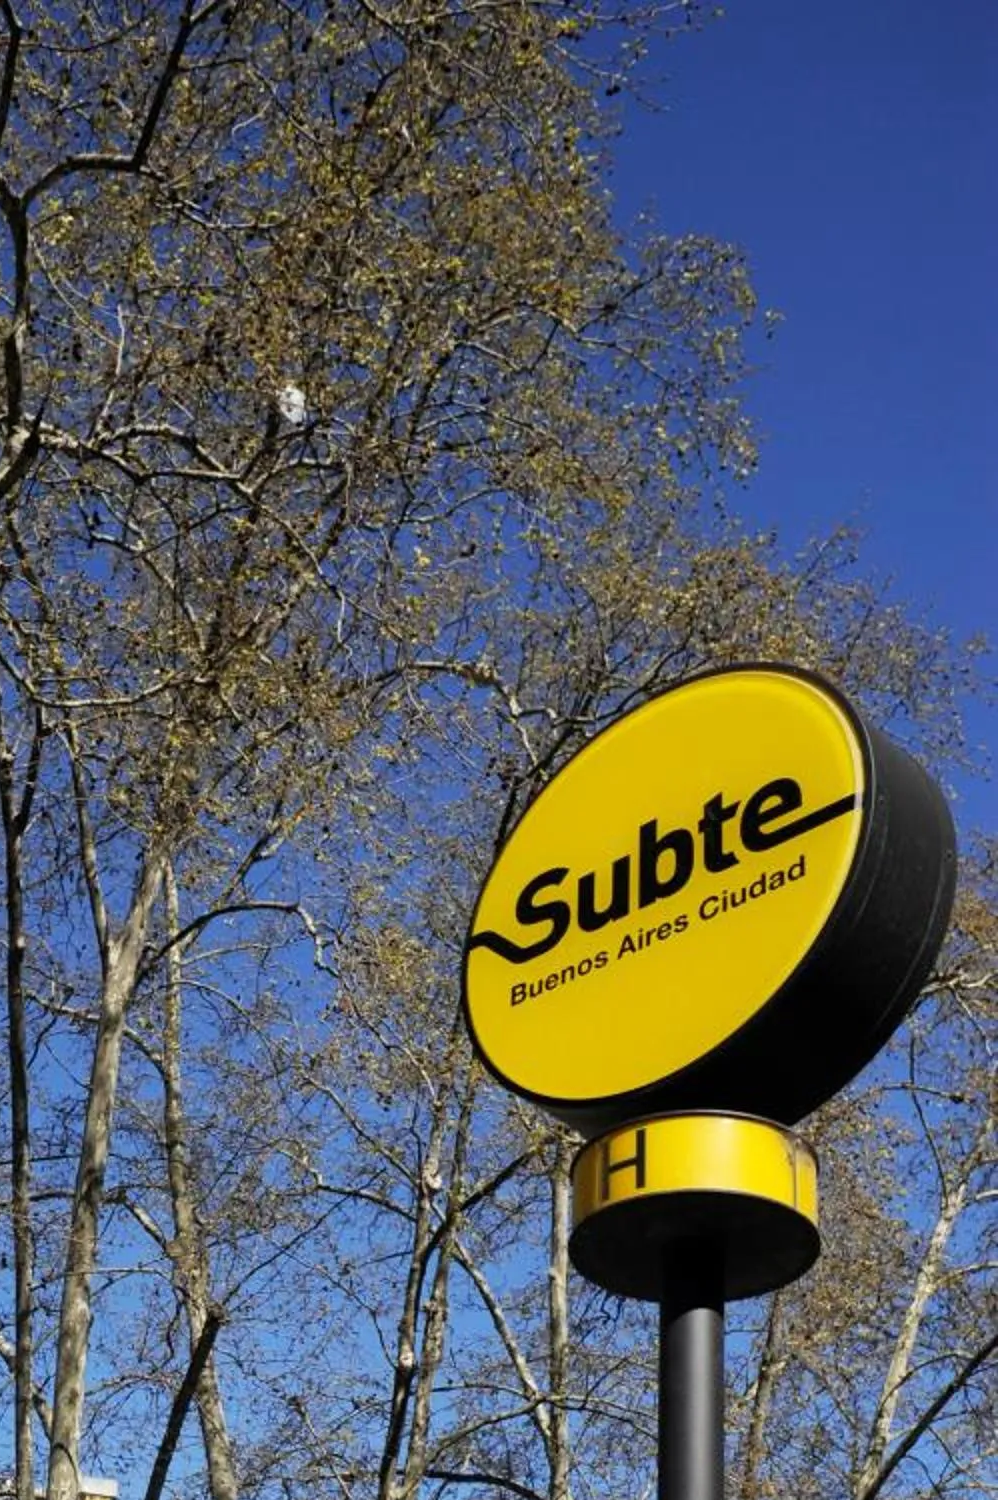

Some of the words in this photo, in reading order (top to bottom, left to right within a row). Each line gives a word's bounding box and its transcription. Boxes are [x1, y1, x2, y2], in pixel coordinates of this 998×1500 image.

[469, 777, 857, 964] Subte
[510, 950, 609, 1007] Buenos
[617, 913, 689, 960] Aires
[698, 855, 807, 921] Ciudad
[602, 1128, 646, 1201] H
